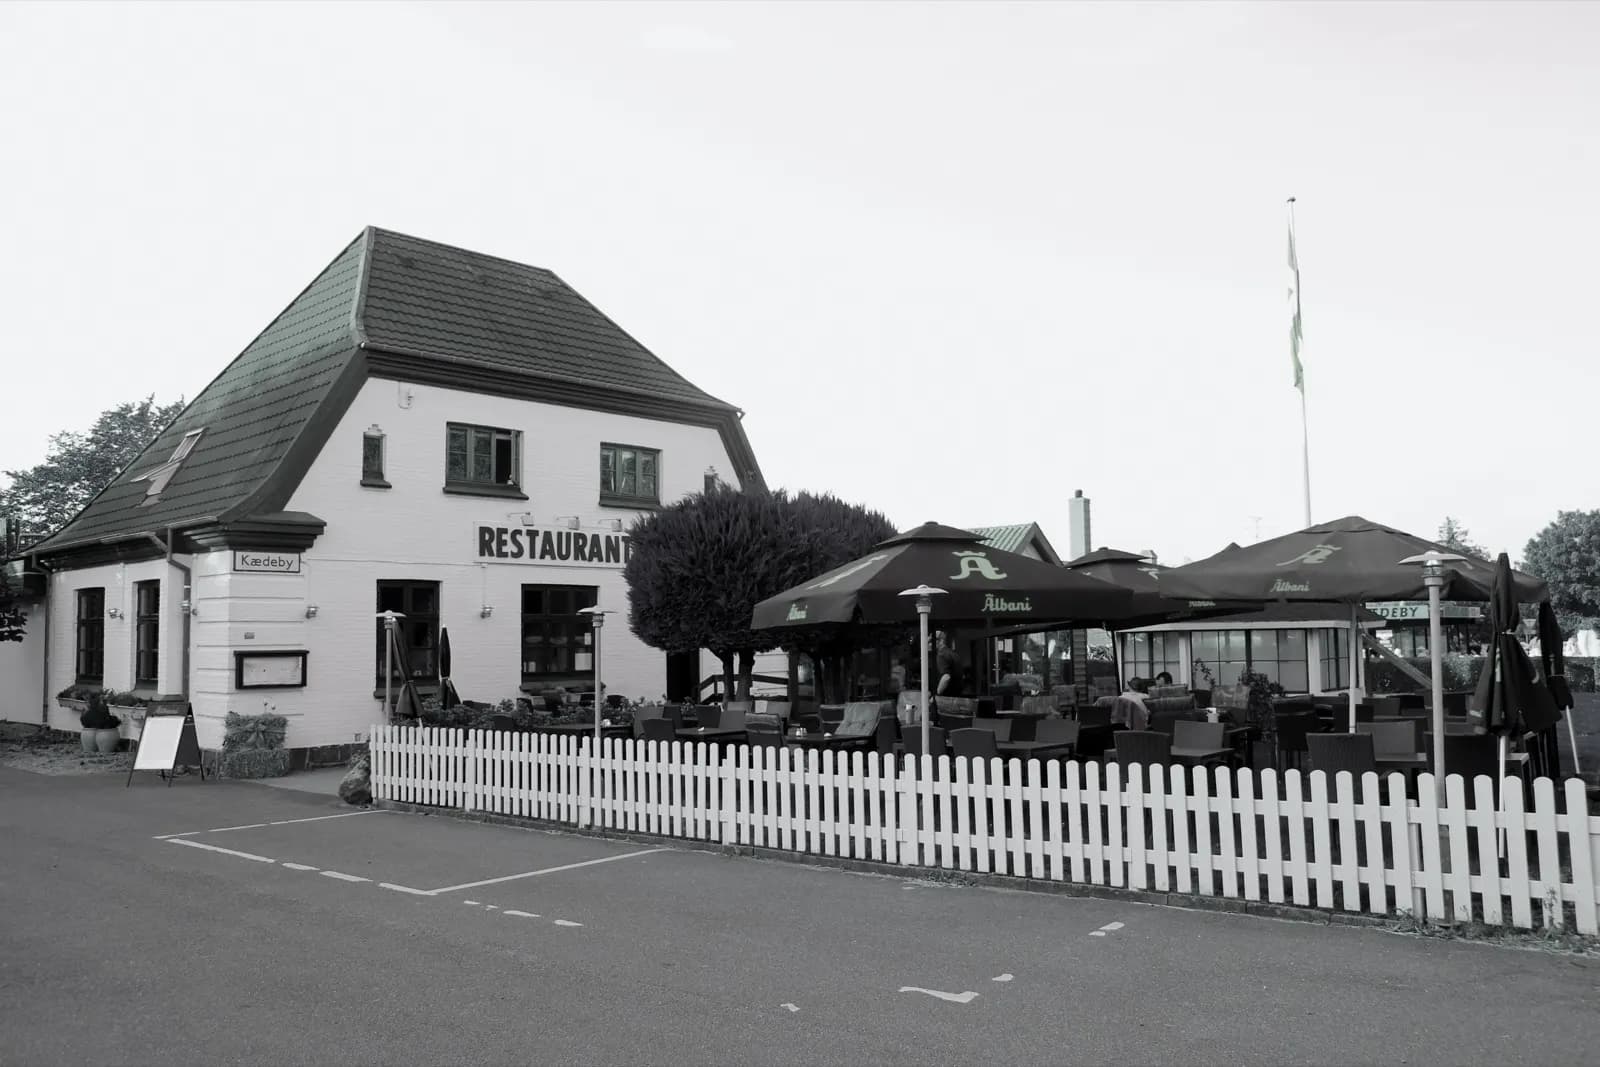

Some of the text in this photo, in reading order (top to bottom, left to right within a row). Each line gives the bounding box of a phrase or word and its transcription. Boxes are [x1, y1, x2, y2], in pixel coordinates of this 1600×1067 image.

[478, 526, 632, 564] RESTAURANT
[241, 554, 294, 570] Kædeby
[981, 594, 1032, 611] Albani
[1373, 607, 1418, 618] DEBY
